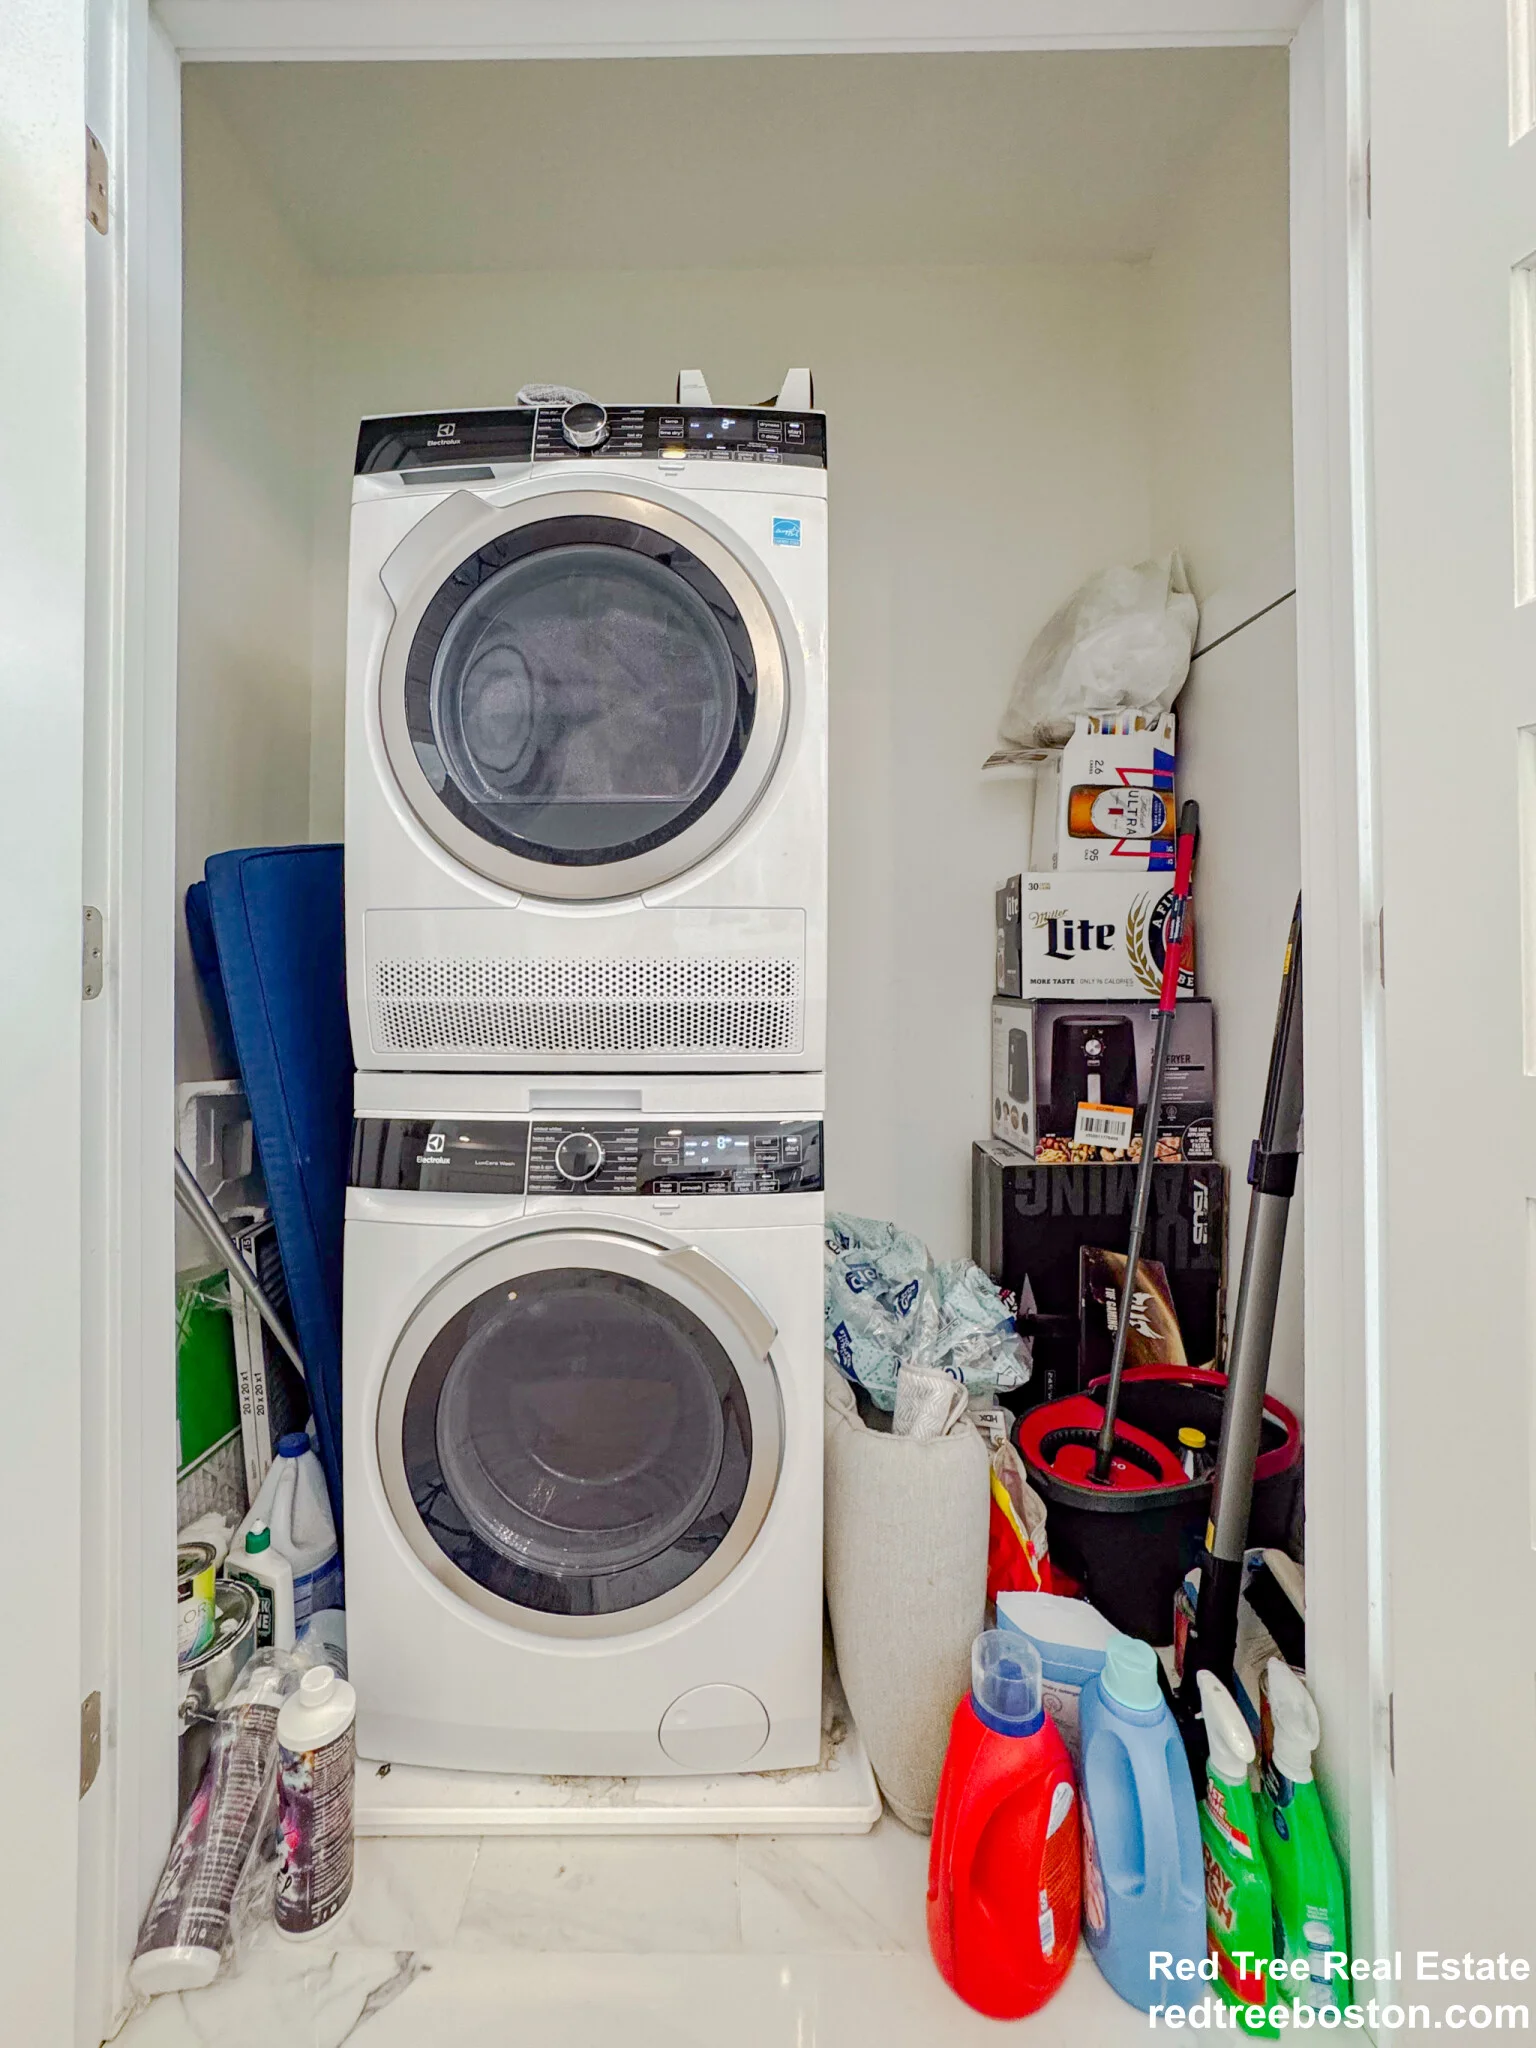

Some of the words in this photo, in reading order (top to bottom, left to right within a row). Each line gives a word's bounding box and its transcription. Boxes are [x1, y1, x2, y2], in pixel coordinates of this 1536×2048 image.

[427, 439, 466, 447] Electrolux
[1094, 760, 1104, 775] 2.6
[1126, 790, 1139, 835] ULTRA
[1089, 848, 1099, 861] 95
[1028, 883, 1039, 891] 30
[1028, 909, 1069, 929] Miller
[1043, 918, 1115, 960] Lite
[1177, 974, 1194, 986] BE
[1166, 1054, 1191, 1064] FRYER
[717, 1137, 725, 1149] 8
[416, 1155, 451, 1164] Electrolux
[1193, 1179, 1208, 1245] ASUS
[1105, 1287, 1116, 1300] TUF
[1106, 1300, 1118, 1331] GAMING
[241, 1383, 250, 1394] 20
[254, 1384, 263, 1395] 20
[243, 1404, 251, 1415] 20
[256, 1404, 265, 1416] 20
[978, 1413, 998, 1424] HDX
